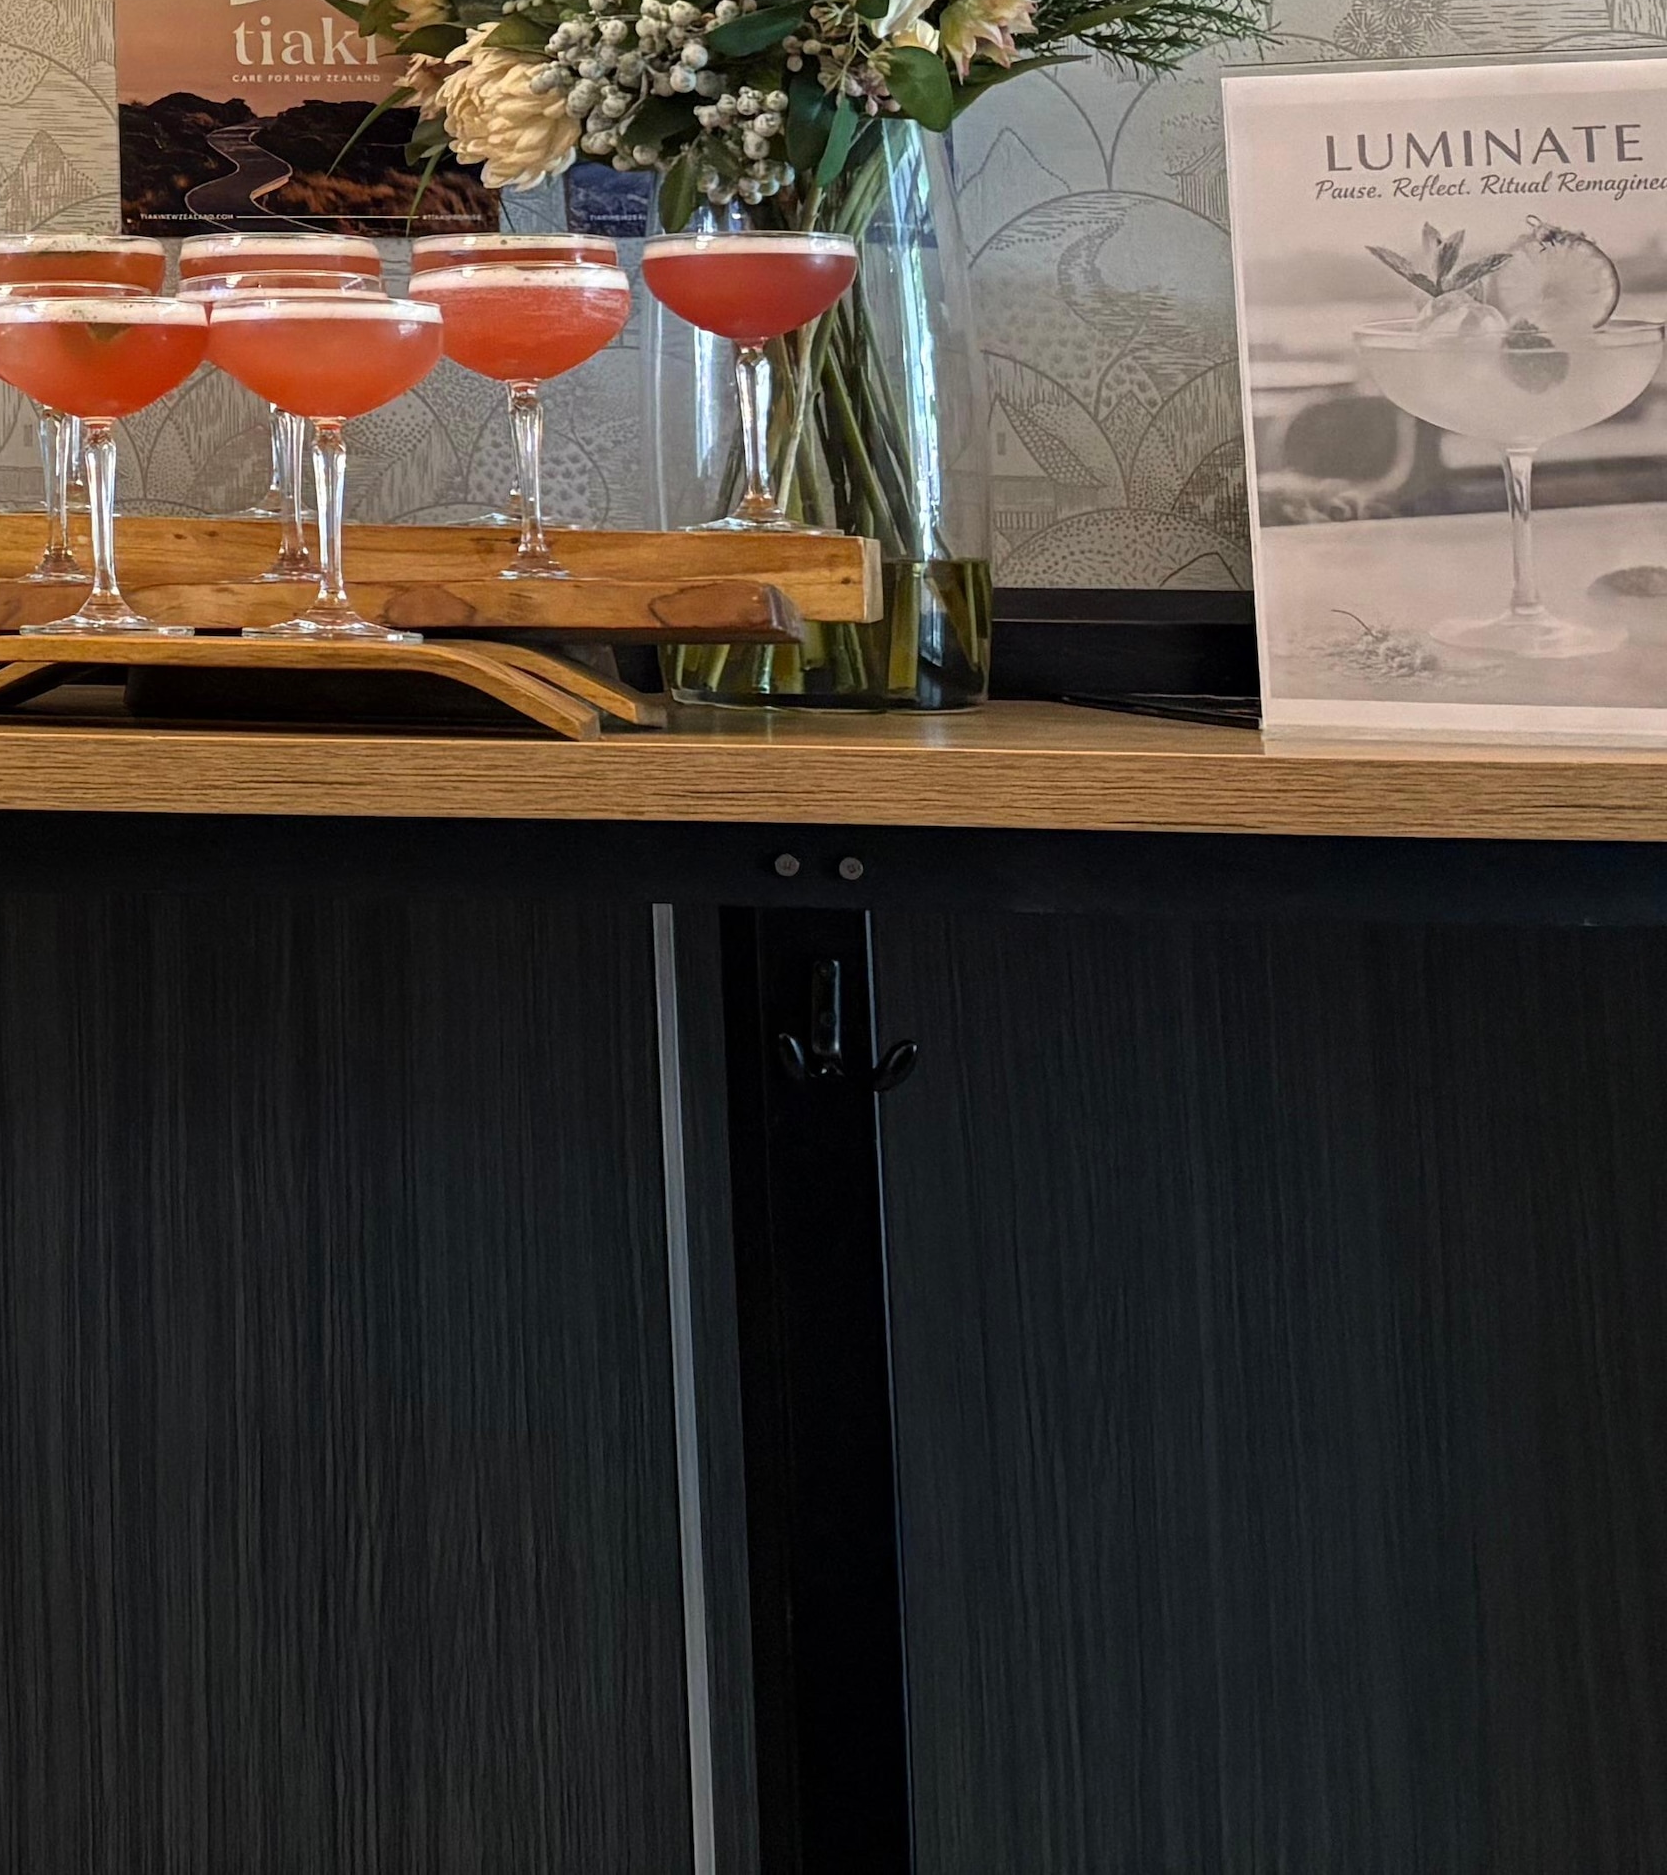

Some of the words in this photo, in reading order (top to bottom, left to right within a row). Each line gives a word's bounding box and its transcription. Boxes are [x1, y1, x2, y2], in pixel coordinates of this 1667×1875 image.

[231, 15, 379, 66] tiaki
[232, 74, 263, 83] CARE
[268, 74, 291, 83] FOR
[295, 74, 321, 83] NEW
[326, 74, 381, 83] ZEALAND
[1325, 124, 1644, 172] LUMINATE
[1315, 178, 1383, 200] Pause.
[1393, 174, 1470, 201] Reflect.
[1481, 171, 1554, 195] Ritual
